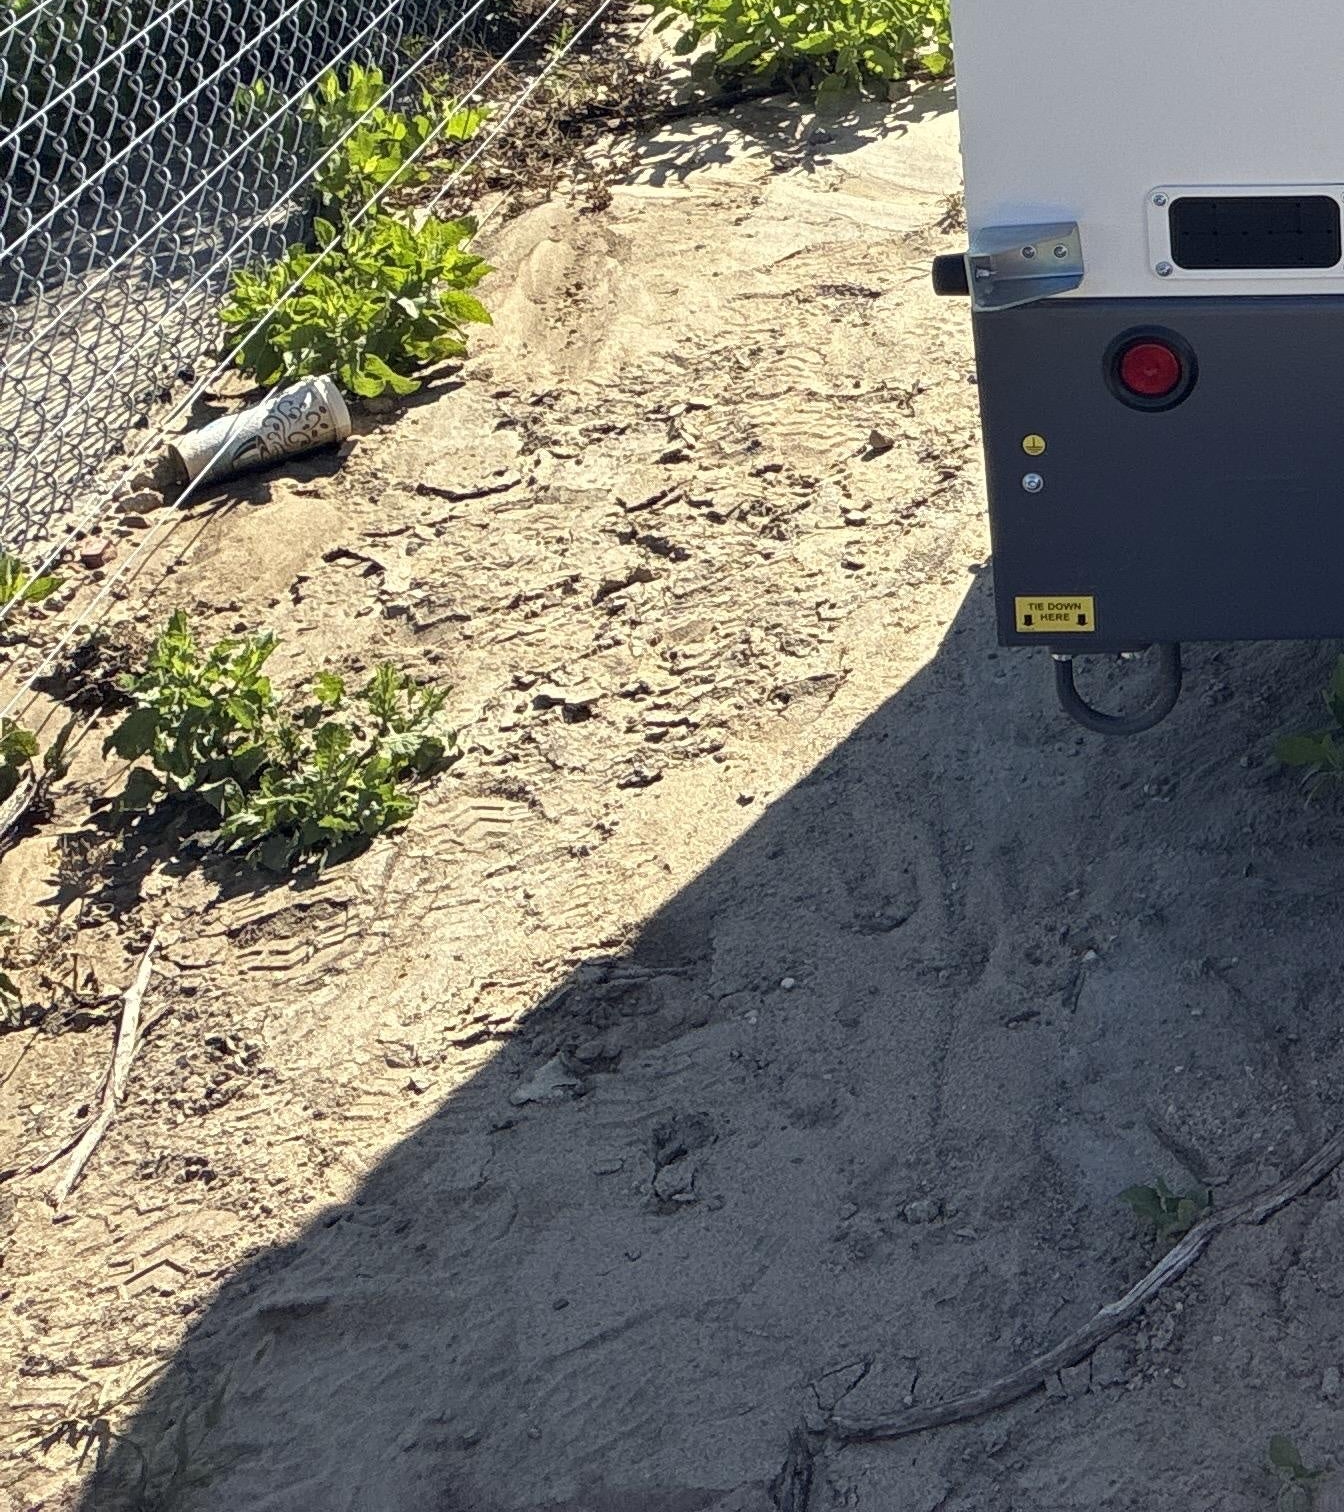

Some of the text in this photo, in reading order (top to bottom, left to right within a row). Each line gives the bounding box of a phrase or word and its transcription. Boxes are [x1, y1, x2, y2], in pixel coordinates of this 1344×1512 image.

[1028, 602, 1082, 611] TIE DOWN
[1040, 613, 1070, 621] HERE
